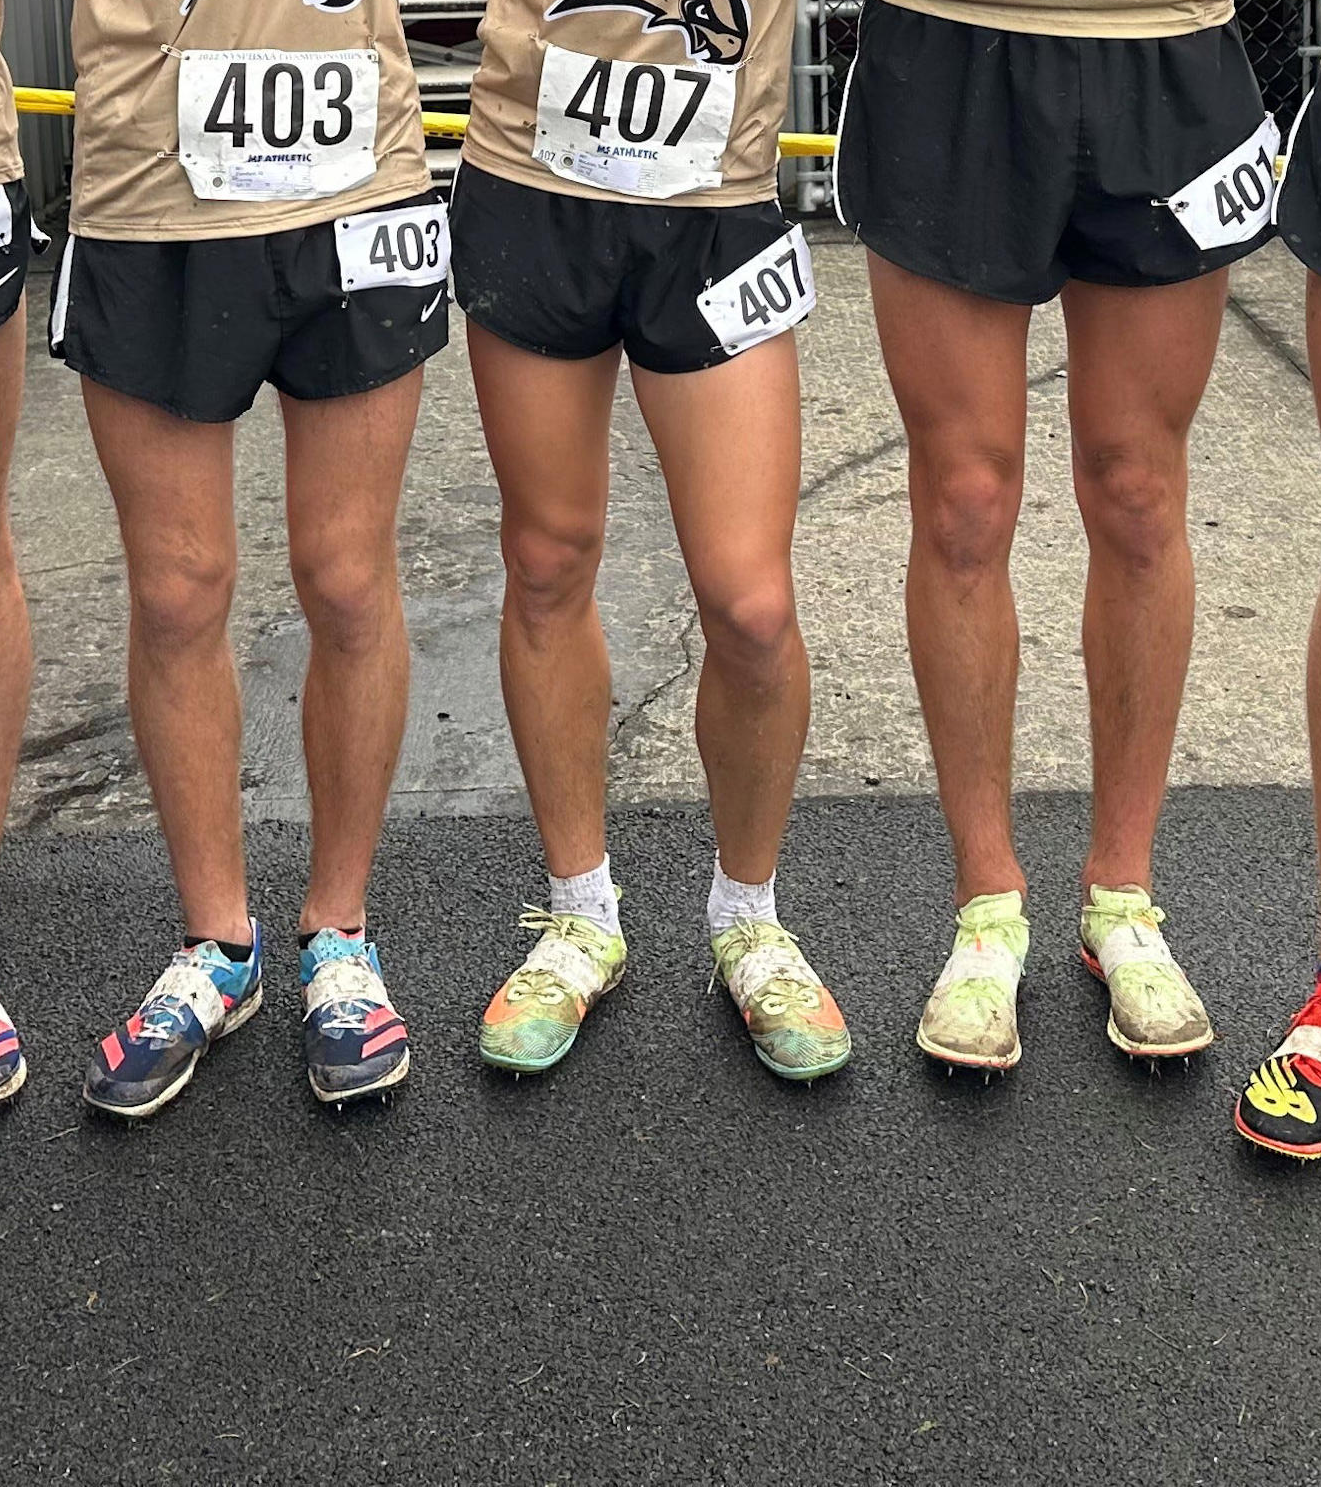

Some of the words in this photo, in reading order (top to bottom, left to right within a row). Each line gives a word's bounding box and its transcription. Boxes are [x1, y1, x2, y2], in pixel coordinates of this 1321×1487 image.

[204, 61, 354, 148] 403
[564, 59, 711, 147] 407
[264, 153, 312, 163] ATHLETIC
[612, 147, 659, 161] ATHLETIC
[1214, 145, 1275, 228] 401
[369, 219, 441, 274] 403
[739, 249, 807, 328] 407
